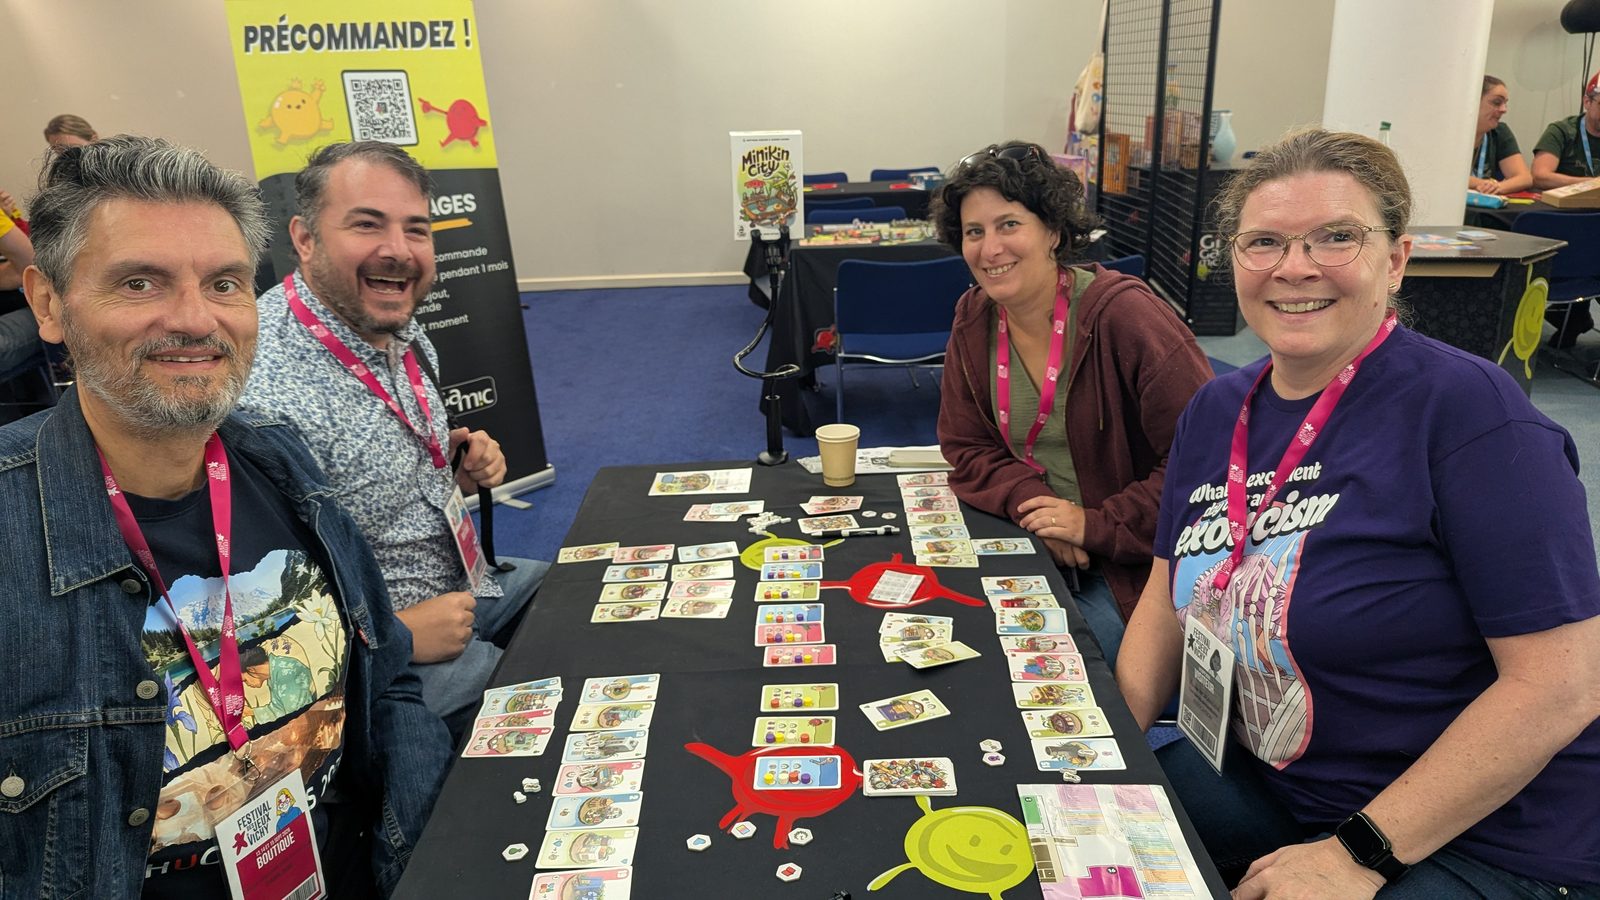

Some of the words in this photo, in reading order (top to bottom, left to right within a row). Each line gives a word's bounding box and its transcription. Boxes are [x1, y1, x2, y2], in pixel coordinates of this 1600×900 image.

[244, 14, 456, 53] PRÉCOMMANDEZ
[463, 19, 472, 48] !
[439, 265, 480, 283] pendant
[481, 263, 486, 273] 1
[487, 260, 508, 272] mois
[428, 314, 469, 331] moment
[1246, 461, 1322, 488] exclent
[237, 801, 272, 830] FESTIVAL
[253, 812, 271, 833] JEUX
[247, 824, 269, 846] VICHY
[256, 832, 295, 869] BOUTIQUE
